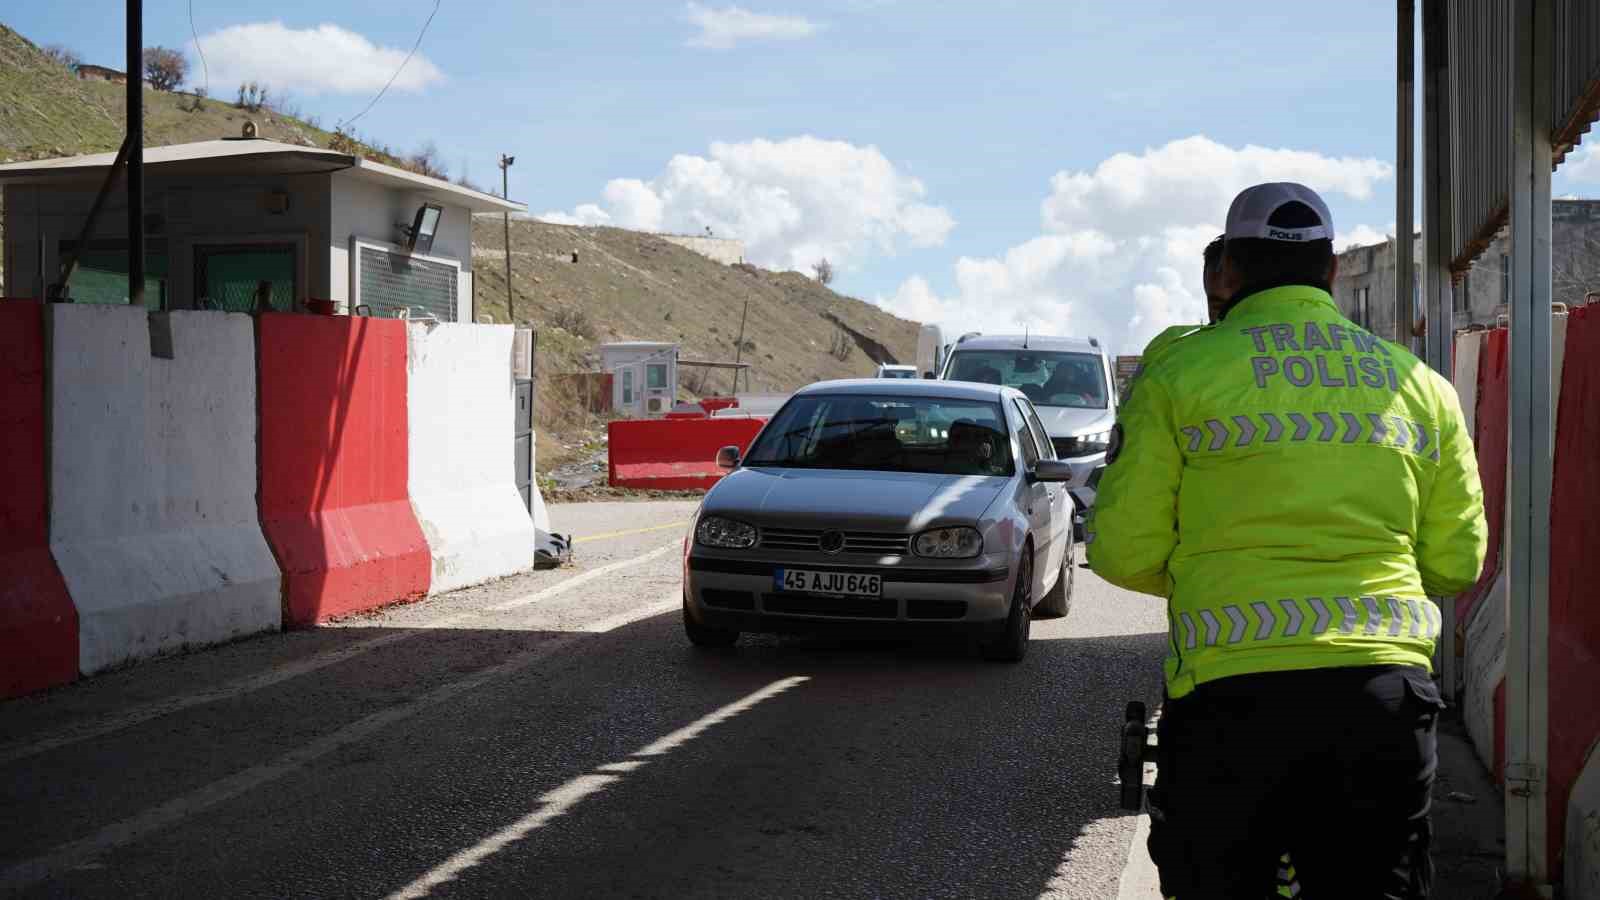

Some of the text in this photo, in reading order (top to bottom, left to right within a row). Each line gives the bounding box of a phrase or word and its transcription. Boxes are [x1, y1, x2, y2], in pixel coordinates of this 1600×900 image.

[785, 571, 805, 589] 45
[812, 573, 843, 591] AJU
[847, 575, 879, 594] 646
